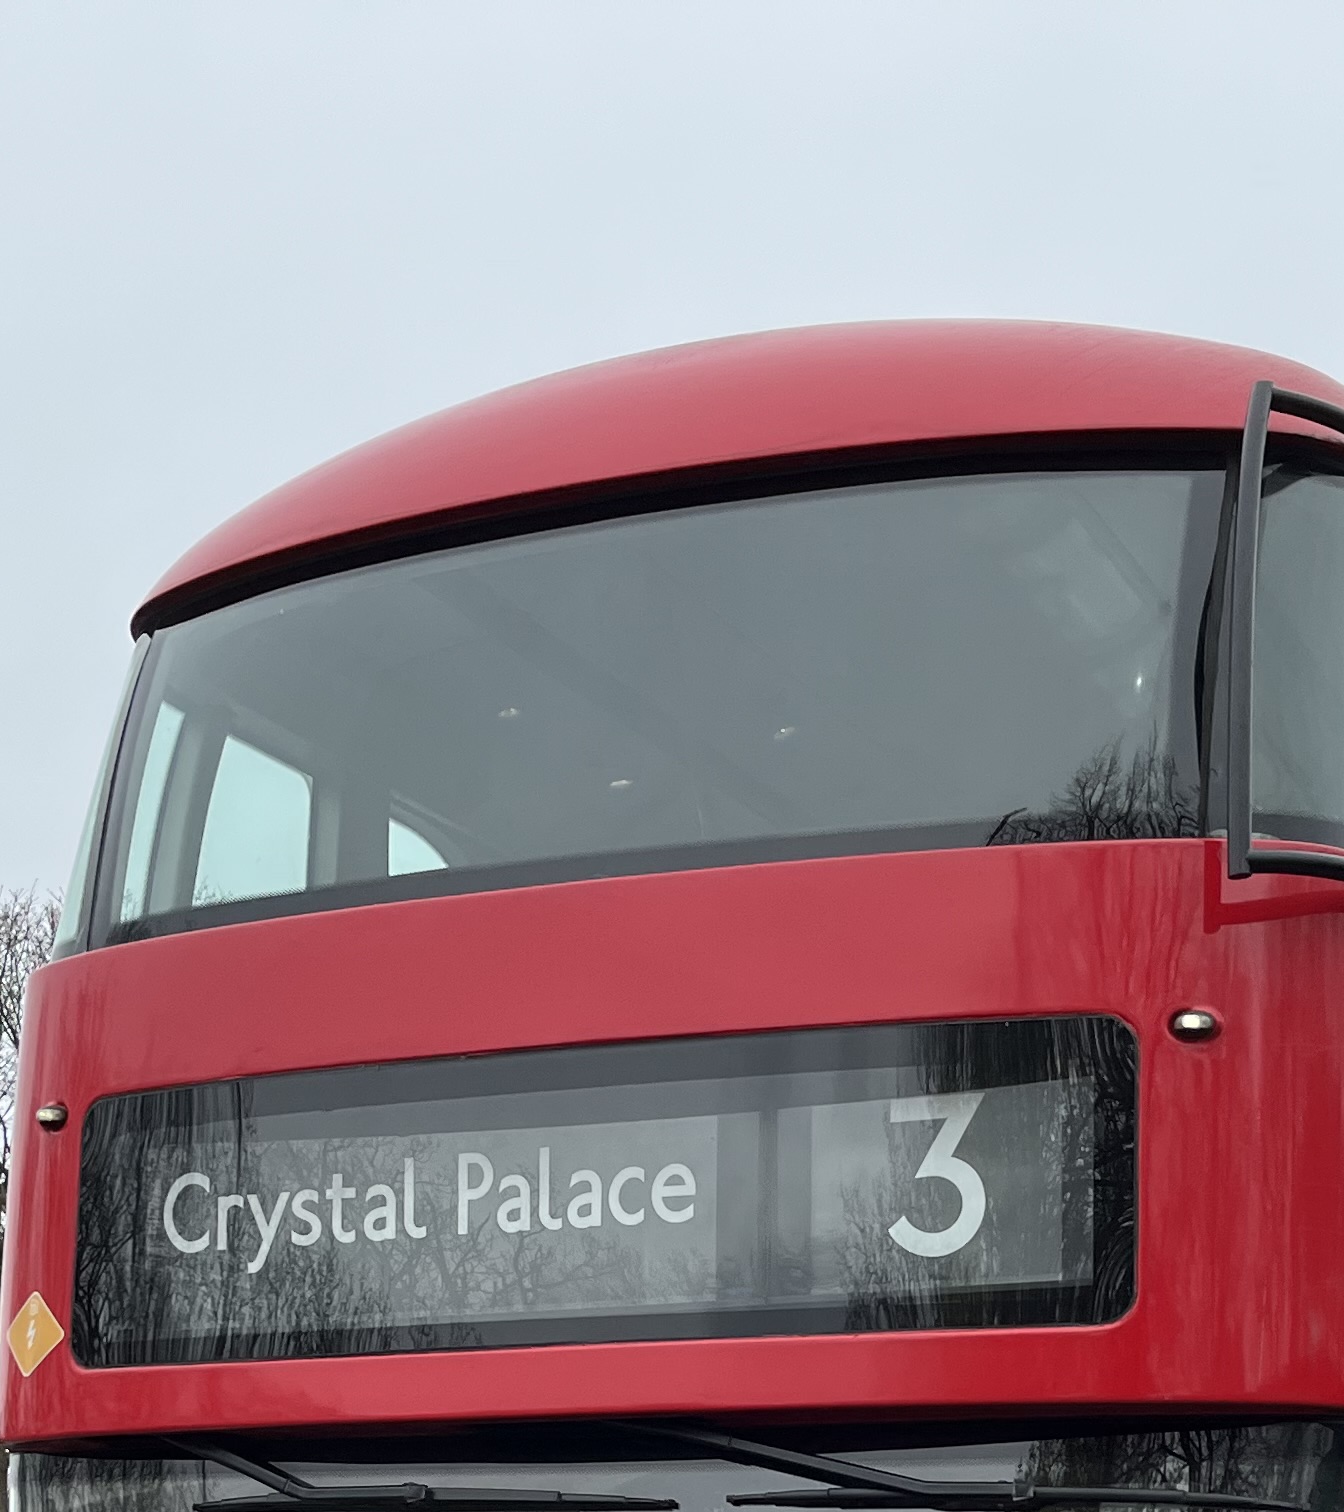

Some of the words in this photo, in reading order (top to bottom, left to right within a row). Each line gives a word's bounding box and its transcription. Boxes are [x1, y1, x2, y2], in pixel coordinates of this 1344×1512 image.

[163, 1158, 427, 1274] Crystal
[458, 1147, 696, 1235] Palace
[888, 1093, 986, 1258] 3
